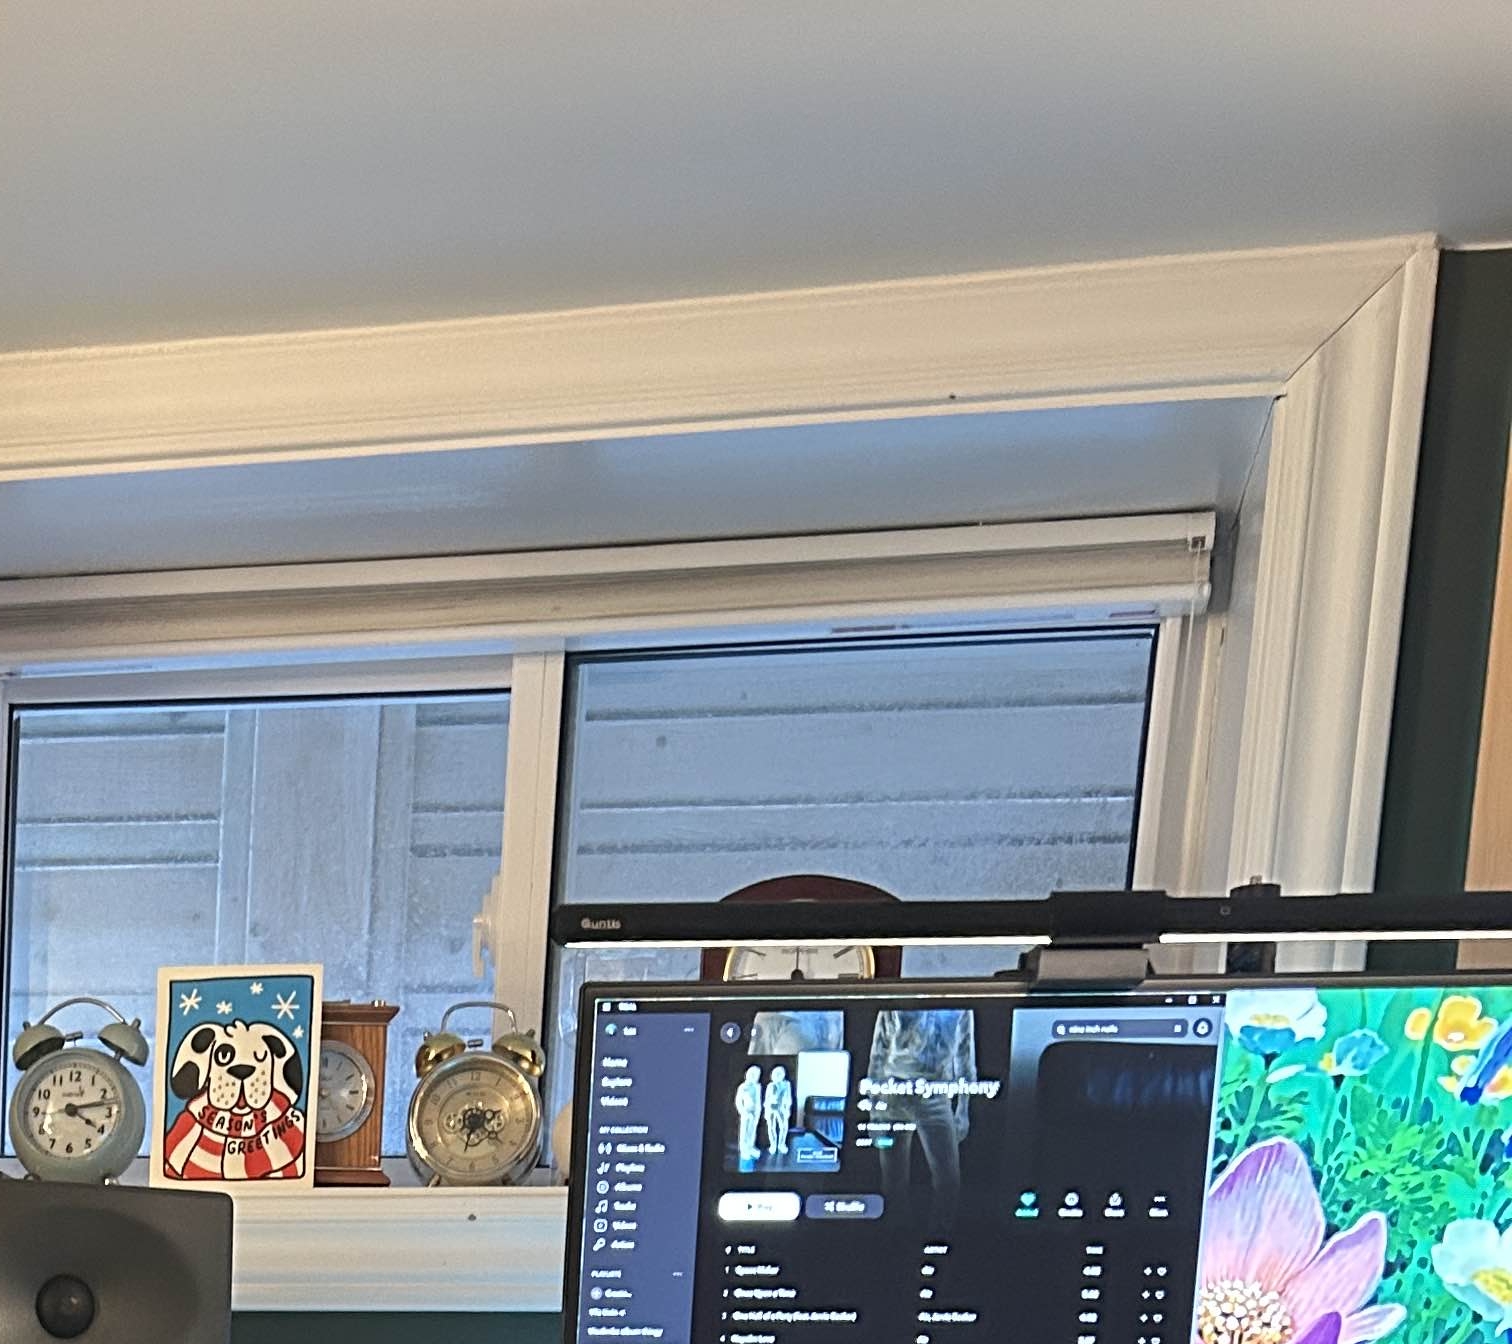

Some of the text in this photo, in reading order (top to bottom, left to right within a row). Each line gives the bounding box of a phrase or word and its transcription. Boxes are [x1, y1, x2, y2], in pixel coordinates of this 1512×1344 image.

[52, 1075, 64, 1087] 11
[70, 1070, 82, 1083] 12
[91, 1075, 96, 1086] 1
[859, 1077, 1001, 1099] Pocket Symphony
[38, 1089, 51, 1101] 10
[100, 1089, 108, 1100] 2
[32, 1106, 40, 1118] 9
[105, 1107, 113, 1119] 3
[198, 1106, 267, 1132] SEASON'S
[97, 1124, 105, 1135] 4
[228, 1110, 301, 1155] GREETINGS
[48, 1138, 56, 1149] 7
[65, 1142, 74, 1153] 6
[85, 1138, 92, 1149] 5
